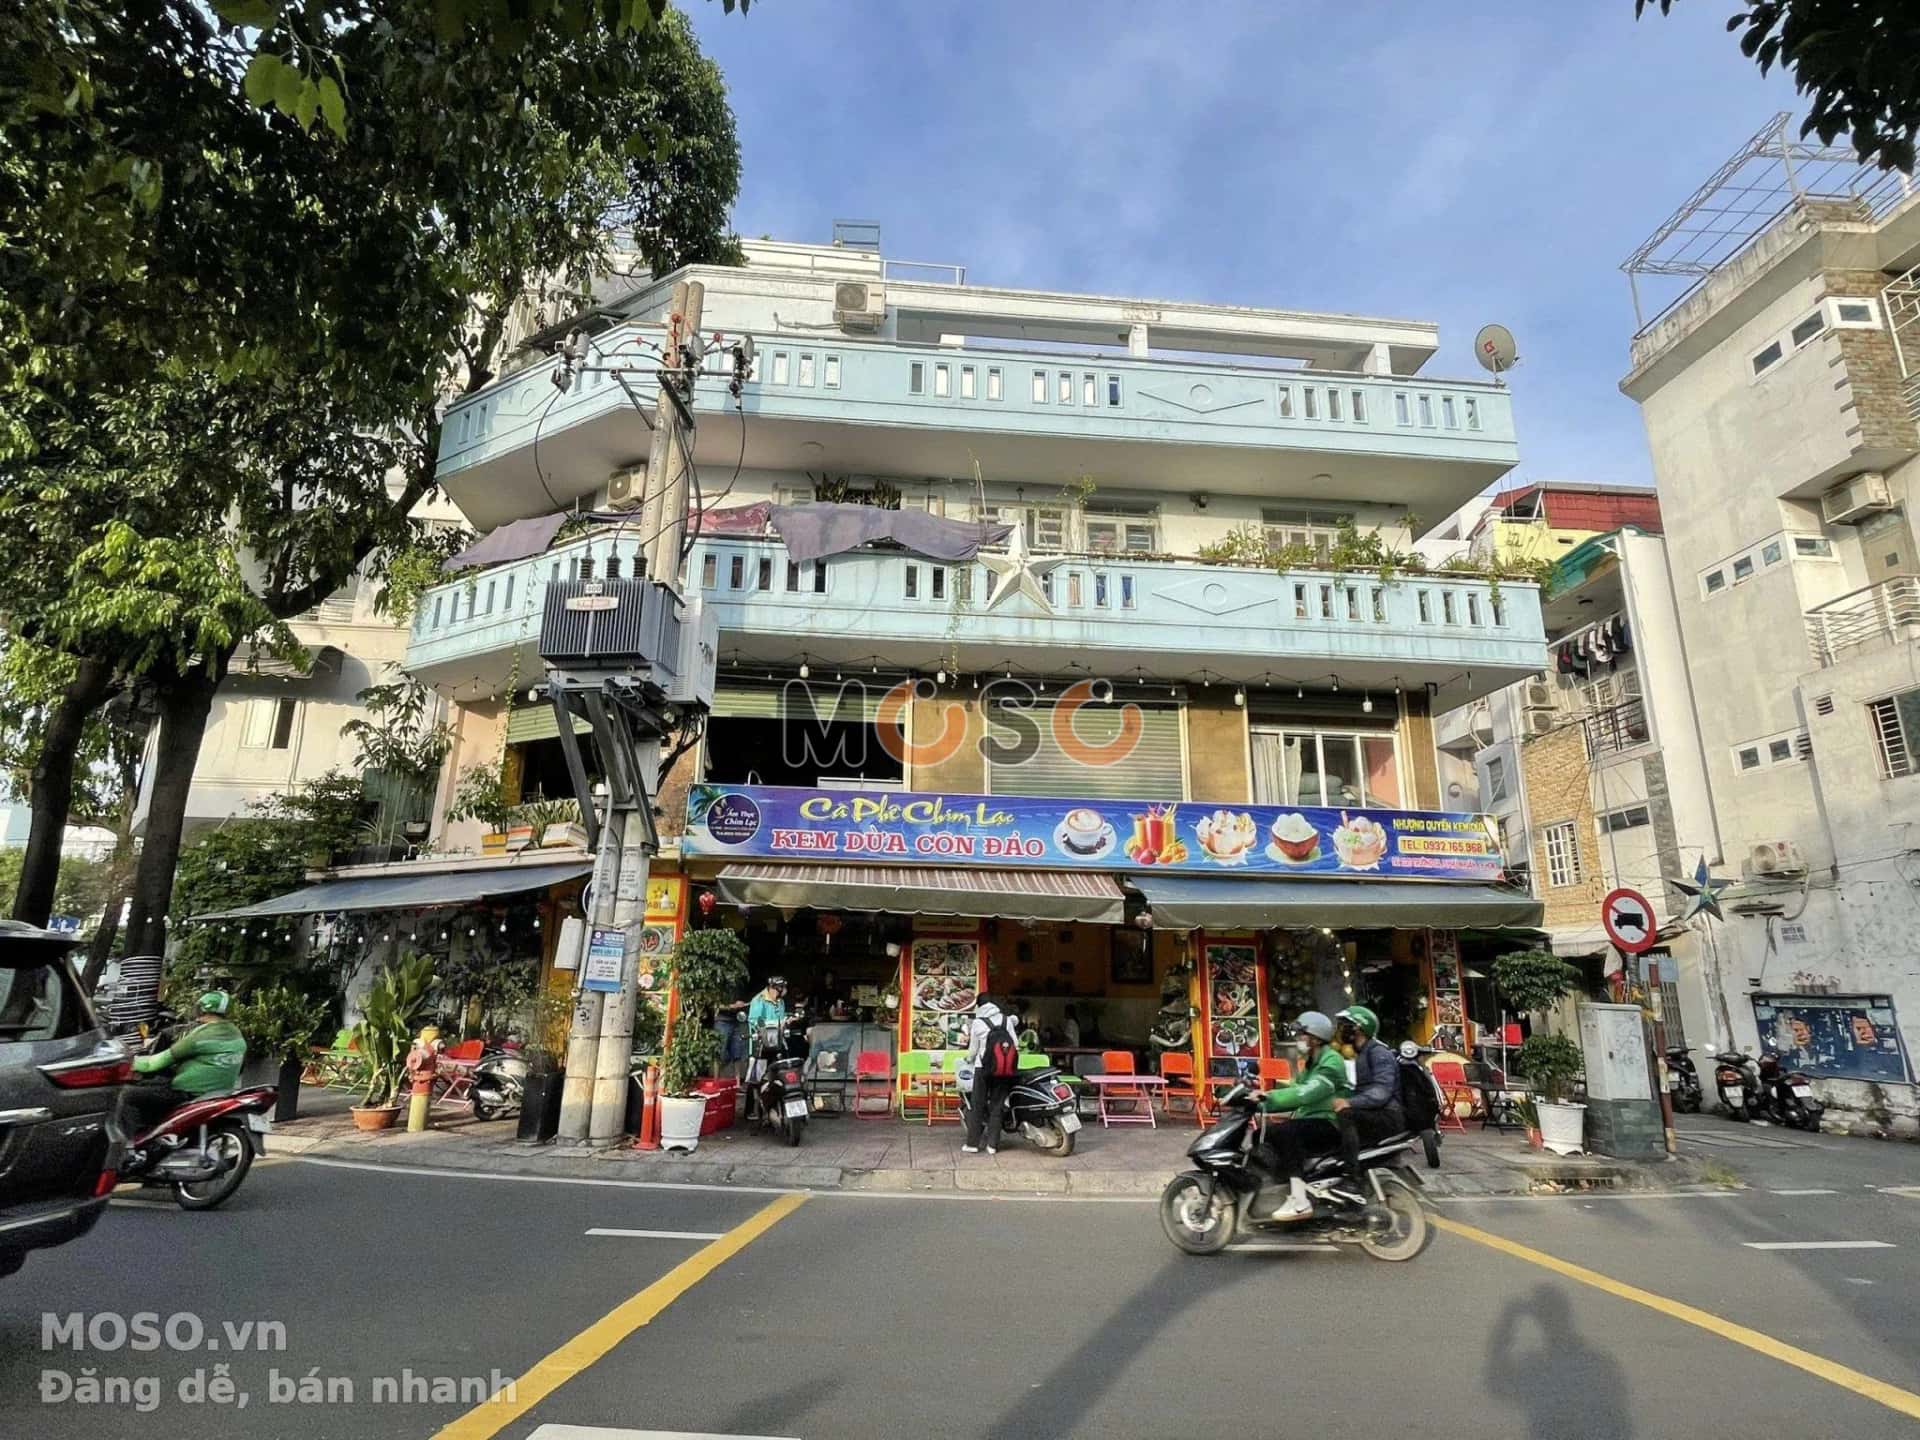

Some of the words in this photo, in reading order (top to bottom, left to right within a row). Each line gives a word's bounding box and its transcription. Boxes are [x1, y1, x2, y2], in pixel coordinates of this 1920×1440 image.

[851, 794, 901, 824] Phê
[902, 796, 971, 828] Chim
[771, 830, 837, 851] KEM
[844, 824, 907, 853] DỪA
[915, 831, 976, 855] CÔN
[984, 830, 1045, 857] ĐẢO
